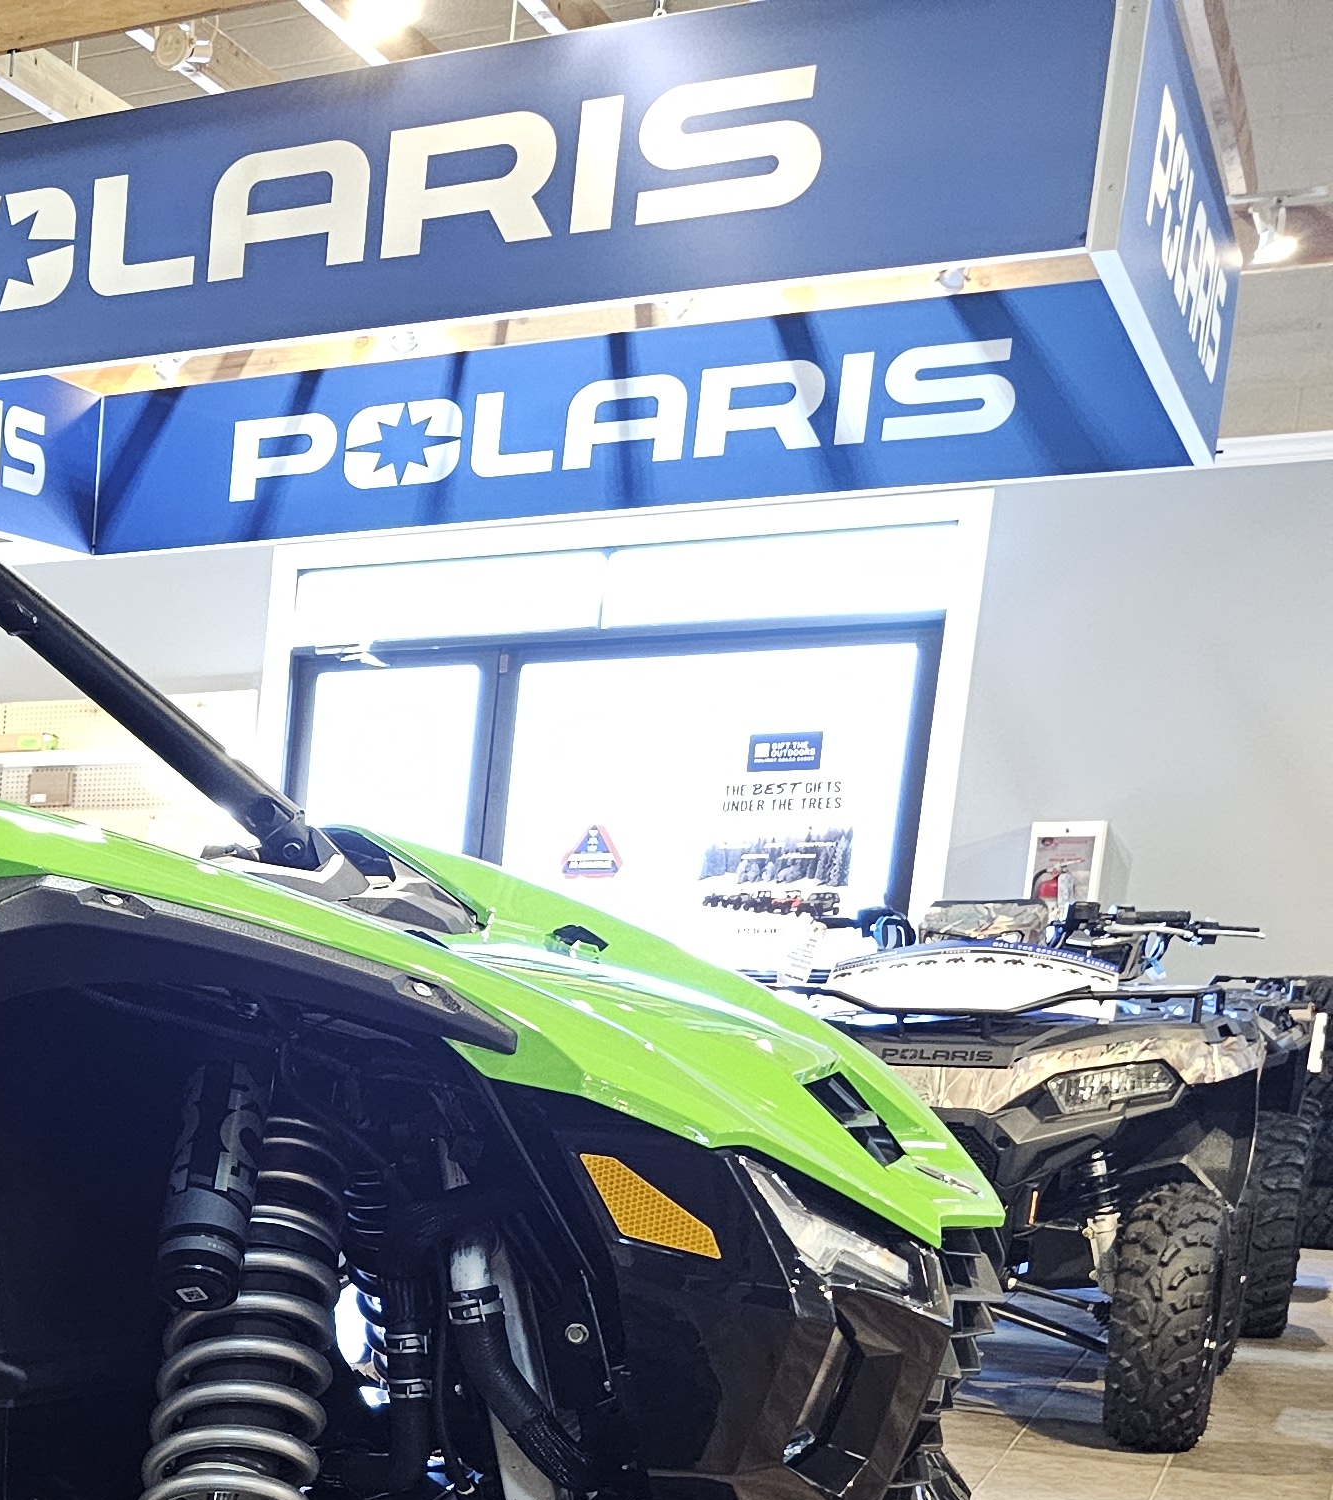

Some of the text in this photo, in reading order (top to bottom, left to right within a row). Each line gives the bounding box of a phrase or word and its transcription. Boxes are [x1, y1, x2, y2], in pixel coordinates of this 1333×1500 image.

[1145, 83, 1228, 384] POLARIS
[228, 338, 1017, 503] POLARIS
[726, 781, 842, 797] THE BEST GIFTS
[722, 796, 842, 813] UNDER THE TREES
[880, 1047, 994, 1062] POLARIS
